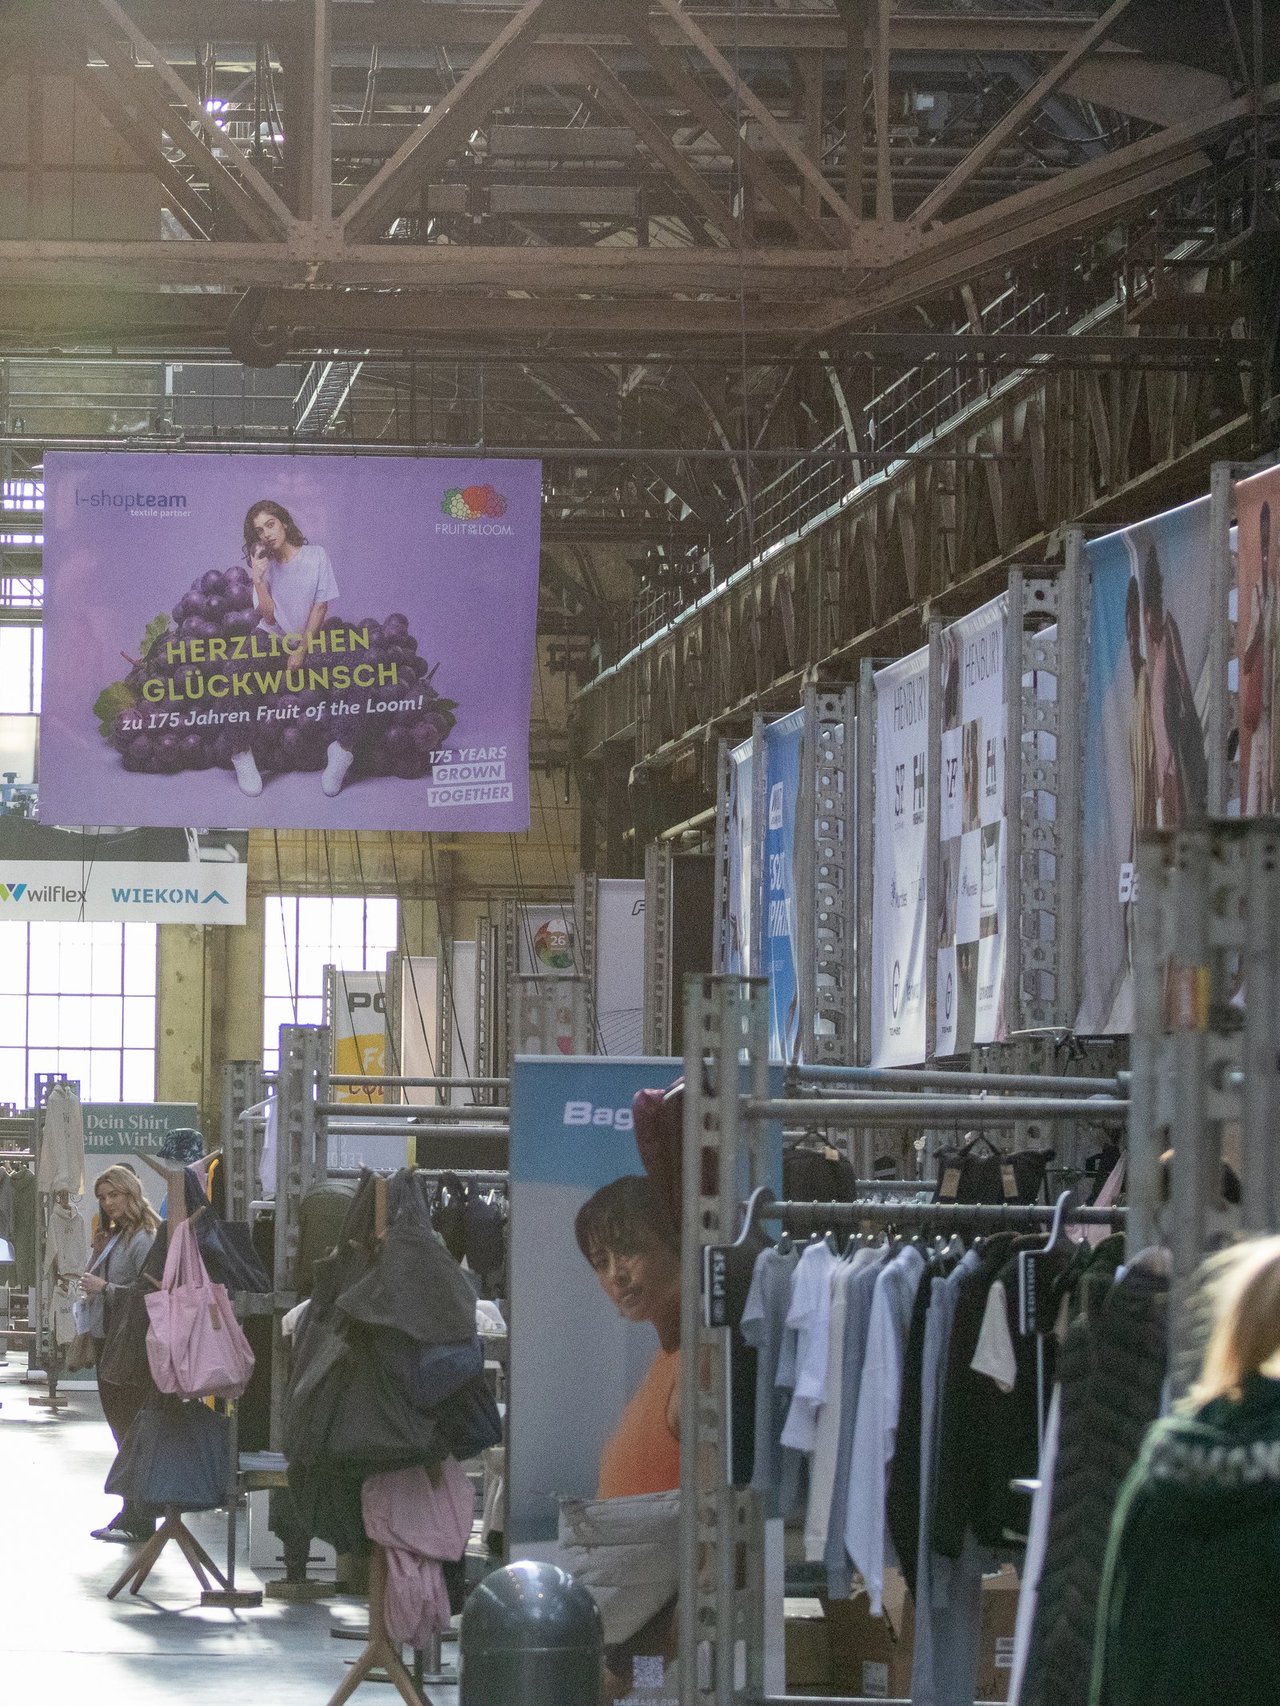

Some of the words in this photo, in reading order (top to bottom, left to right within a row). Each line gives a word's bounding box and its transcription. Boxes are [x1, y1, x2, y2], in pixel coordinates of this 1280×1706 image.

[130, 508, 158, 517] textile
[160, 510, 191, 519] partner
[435, 523, 467, 535] FRUIT
[166, 627, 370, 665] HERZLICHEN
[142, 662, 398, 702] GLÜCKWUNSCH
[122, 716, 143, 731] zu
[148, 711, 180, 728] 175
[184, 708, 250, 726] Jahren
[256, 705, 300, 722] Fruit
[305, 701, 326, 722] of
[330, 699, 361, 717] the
[366, 694, 424, 714] Loom!
[429, 749, 453, 764] 175
[458, 746, 507, 761] YEARS
[436, 765, 502, 781] GROWN
[430, 786, 510, 804] TOGETHER
[27, 885, 88, 903] wilflex
[111, 887, 199, 904] WIEKON
[86, 1114, 124, 1129] Dein
[128, 1114, 170, 1130] Shirt
[563, 1101, 634, 1131] Bag
[82, 1131, 114, 1147] eine
[117, 1132, 165, 1147] Wirku
